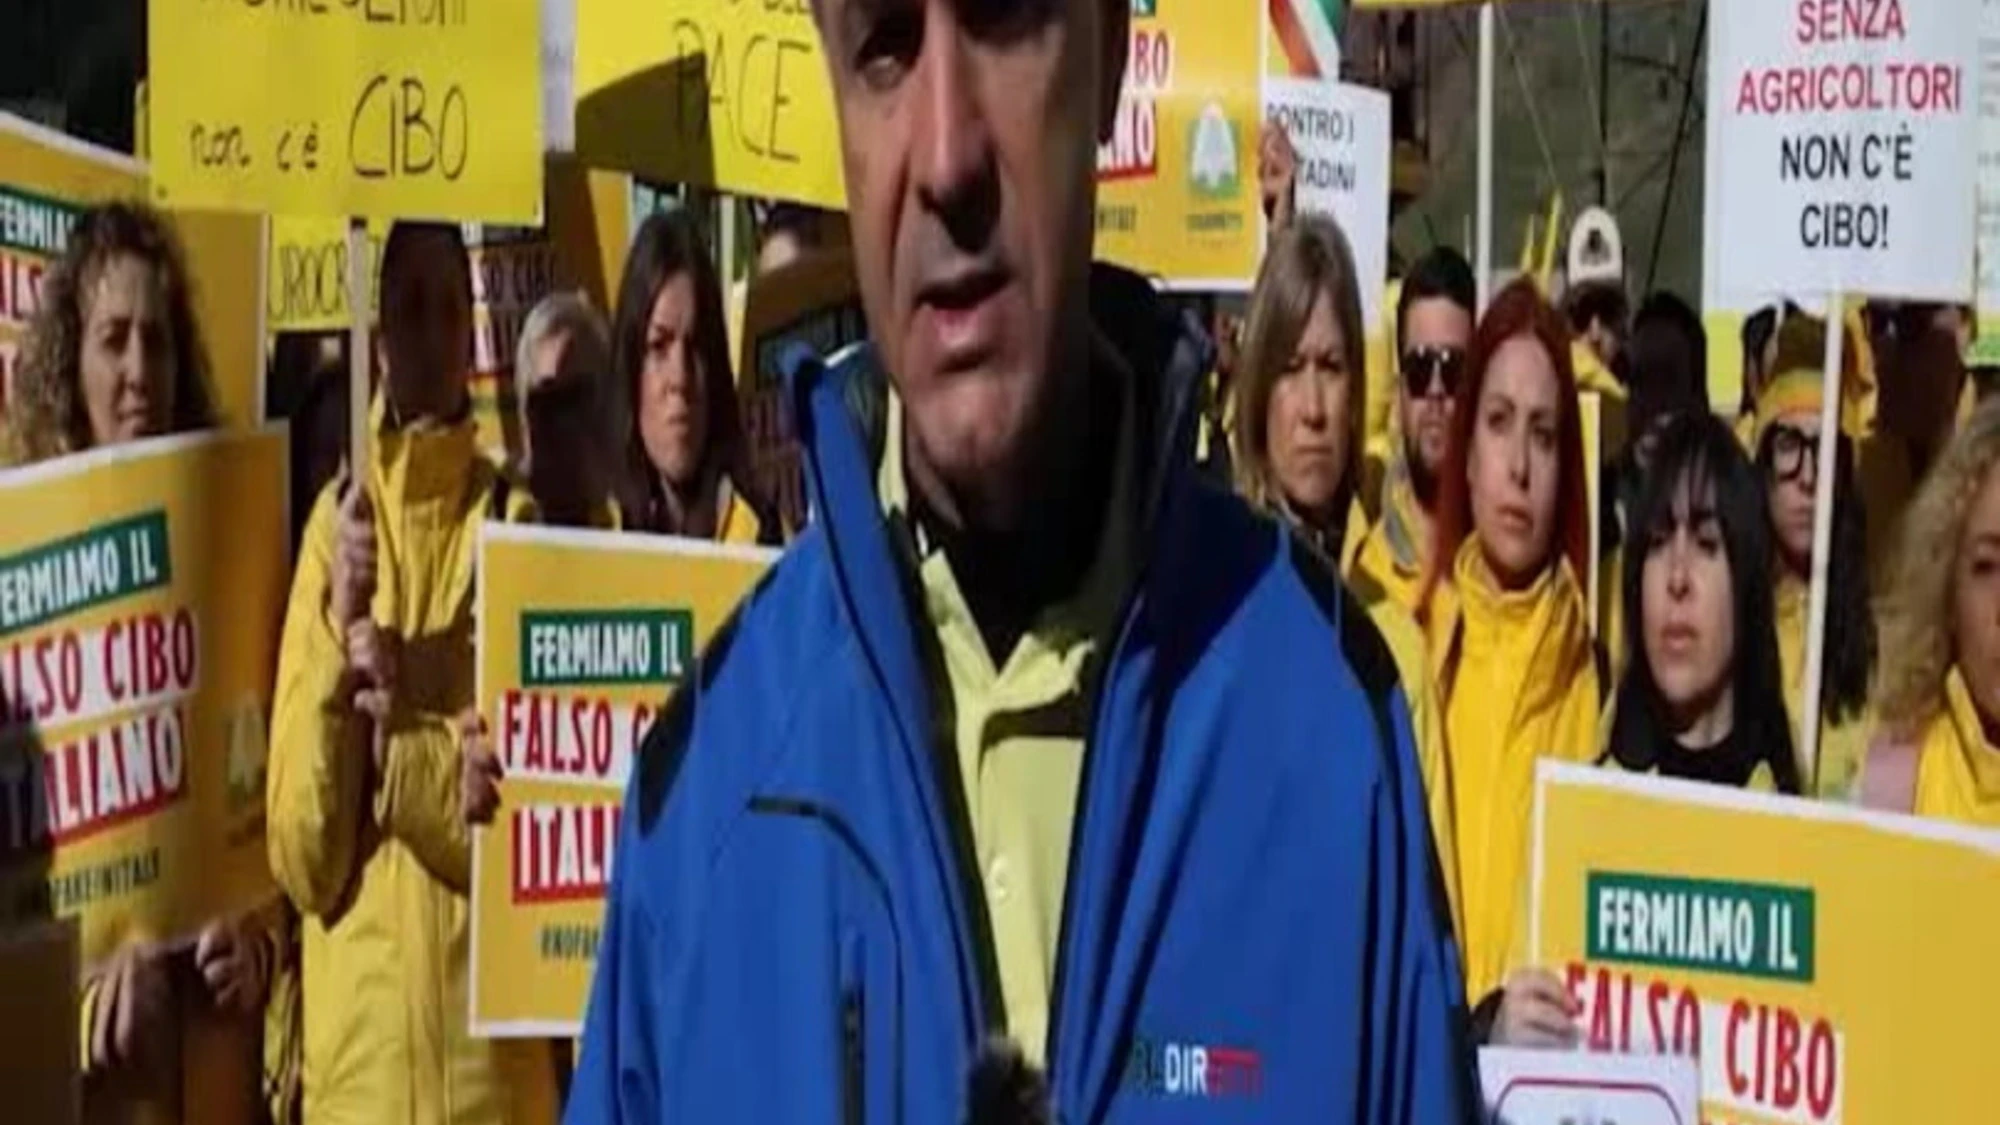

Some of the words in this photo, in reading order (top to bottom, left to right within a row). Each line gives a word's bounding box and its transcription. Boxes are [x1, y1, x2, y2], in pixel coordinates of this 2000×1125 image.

[1134, 29, 1169, 88] BO
[1797, 0, 1905, 43] SENZA
[349, 75, 468, 180] CIBO
[672, 19, 812, 163] PACE
[1736, 63, 1962, 114] AGRICOLTORI
[1780, 134, 1850, 182] NON
[1861, 121, 1913, 182] C'È
[1800, 202, 1889, 250] CIBO!
[0, 536, 120, 627] ERMIAMO
[130, 528, 158, 586] IL
[103, 605, 196, 700] CIBO
[529, 620, 651, 679] FERMIAMO
[660, 622, 683, 676] IL
[503, 690, 612, 779] FALSO
[519, 803, 615, 889] ITALI
[1598, 886, 1755, 969] FERMIAMO
[1768, 902, 1799, 970] IL
[1725, 998, 1837, 1121] CIBO
